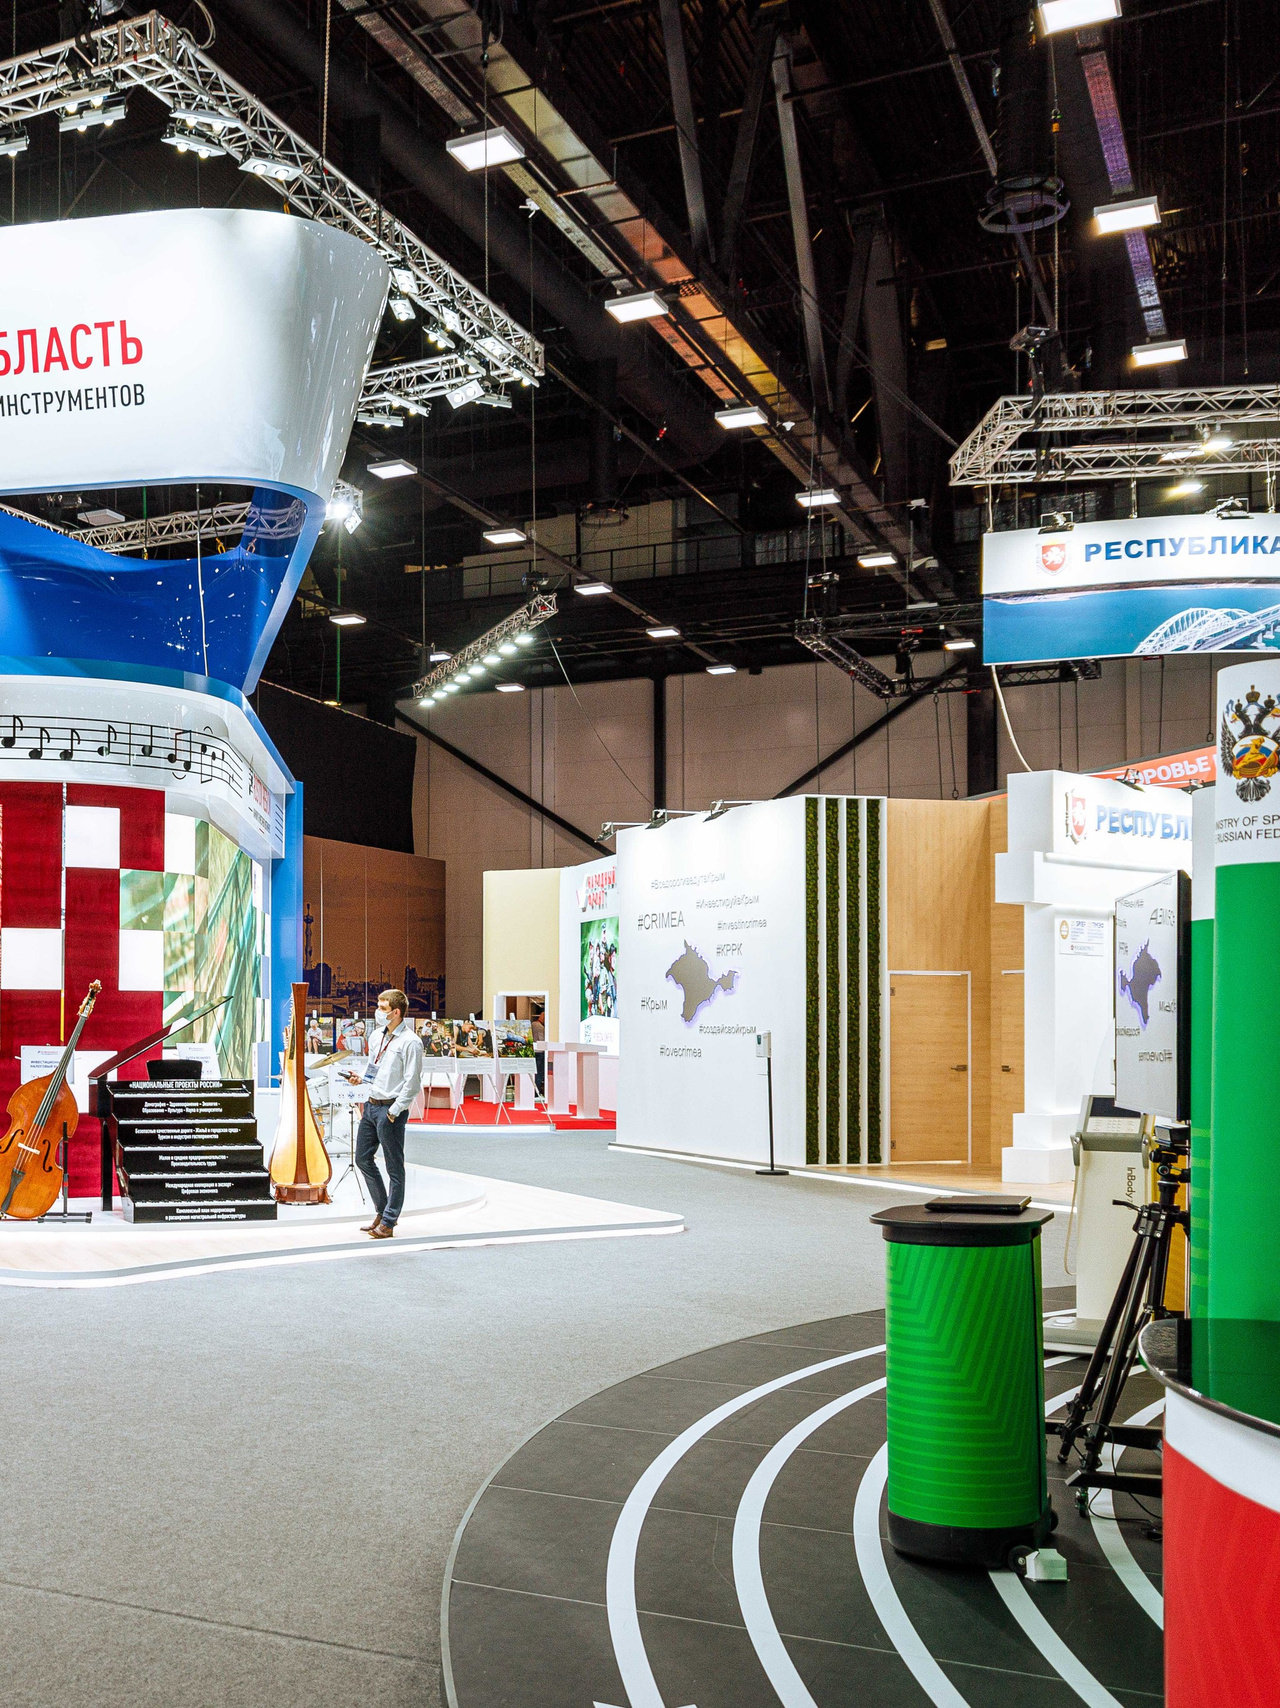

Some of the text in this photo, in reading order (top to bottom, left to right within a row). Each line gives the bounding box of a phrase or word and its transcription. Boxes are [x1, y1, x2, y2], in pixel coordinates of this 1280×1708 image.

[1096, 805, 1192, 841] РЕСПУБЛ
[1242, 816, 1258, 826] OF
[637, 911, 685, 931] #CRIMEA
[641, 997, 668, 1012] #Крым
[660, 1045, 702, 1058] #lovecrimea
[1125, 1167, 1136, 1198] InBody
